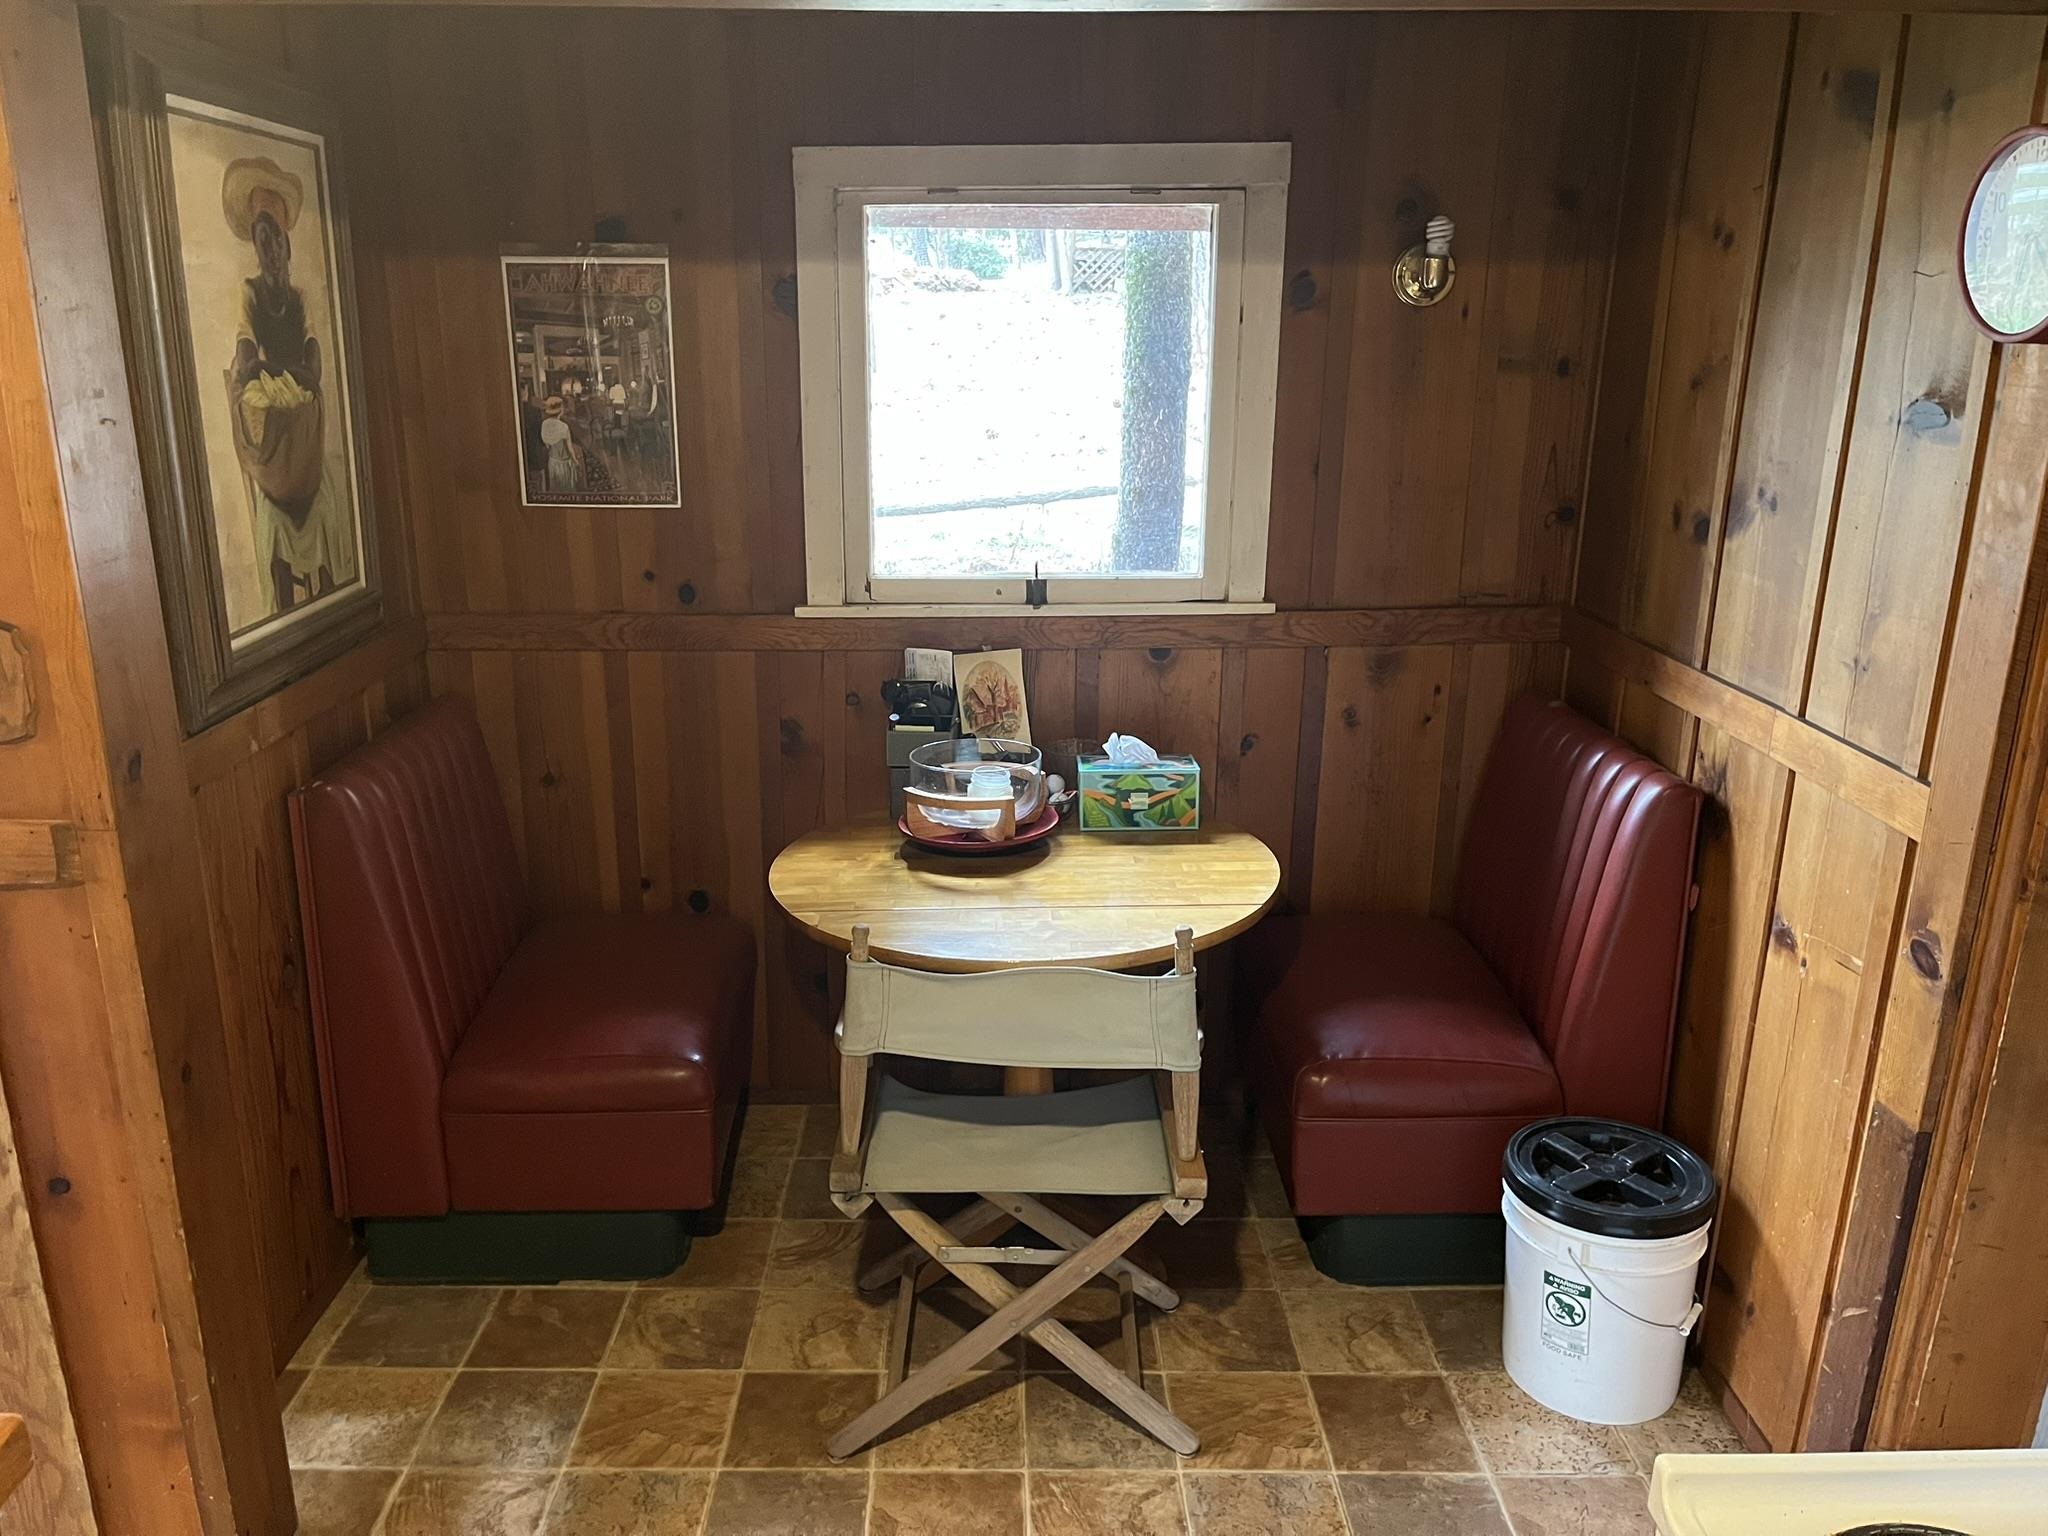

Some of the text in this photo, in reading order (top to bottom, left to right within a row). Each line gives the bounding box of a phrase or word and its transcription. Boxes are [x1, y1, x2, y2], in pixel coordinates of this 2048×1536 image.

[1993, 191, 2006, 213] 10
[1984, 226, 1992, 248] 9
[1554, 1277, 1585, 1291] WARNING
[1559, 1285, 1579, 1295] AVISO
[1542, 1341, 1582, 1361] FOOD SAFE
